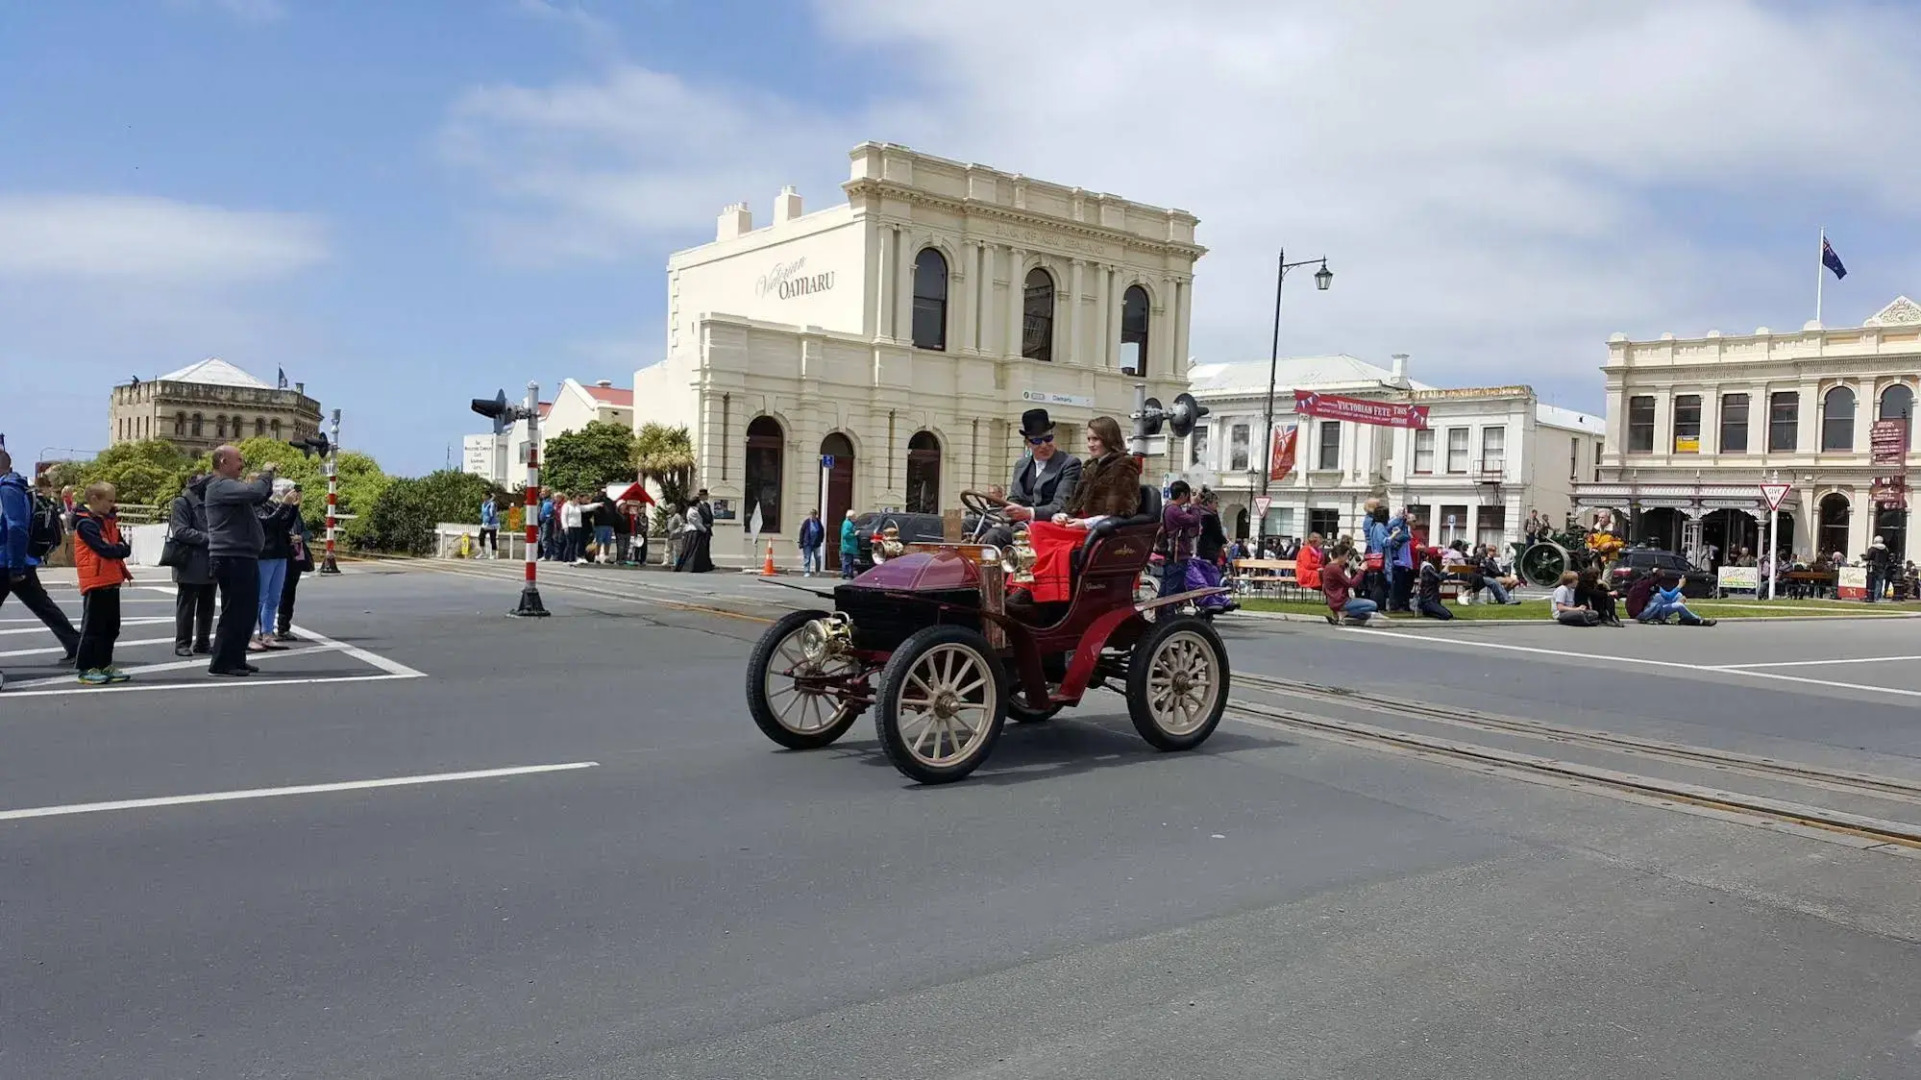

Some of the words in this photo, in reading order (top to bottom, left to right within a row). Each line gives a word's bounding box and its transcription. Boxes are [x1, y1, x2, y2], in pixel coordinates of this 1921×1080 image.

[755, 256, 807, 299] Victorian
[779, 271, 834, 300] OAMARU
[1337, 400, 1373, 414] VICTORIAN
[1374, 405, 1390, 417] FETE
